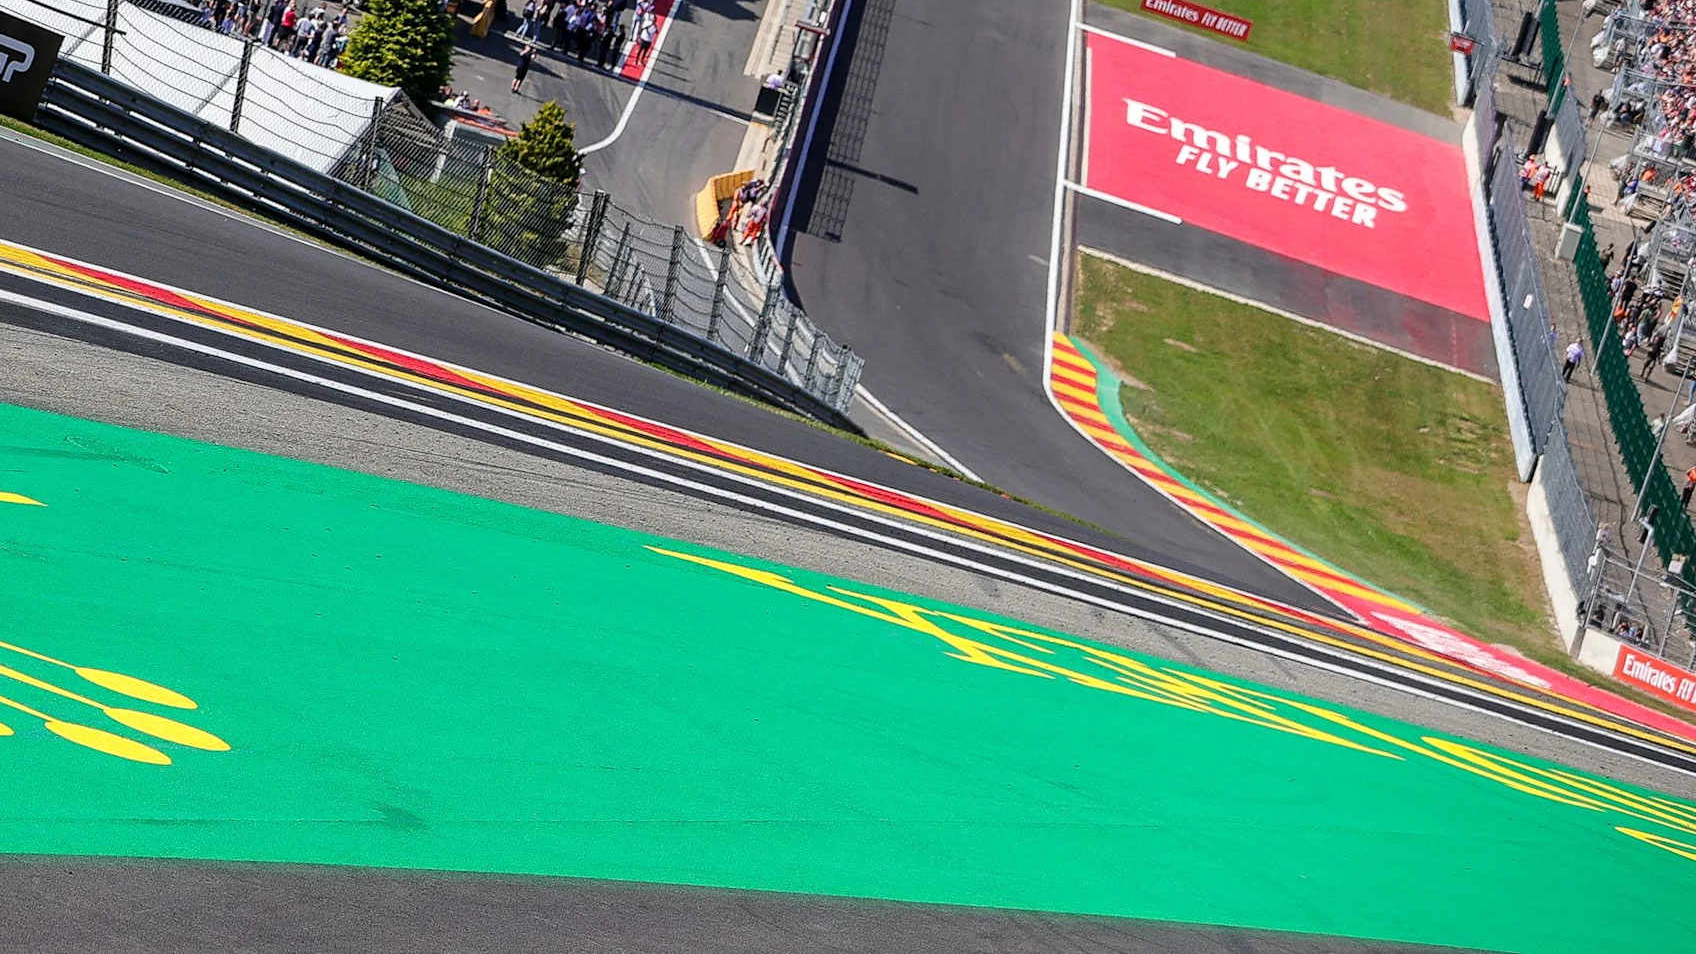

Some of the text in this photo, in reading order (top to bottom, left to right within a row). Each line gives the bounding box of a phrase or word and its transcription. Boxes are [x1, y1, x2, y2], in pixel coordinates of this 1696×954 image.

[1201, 12, 1218, 27] FLY
[1215, 17, 1248, 37] BETTER
[1122, 97, 1408, 214] Emirates
[1175, 144, 1378, 229] FLY BETTER
[1622, 653, 1677, 694] Emirates
